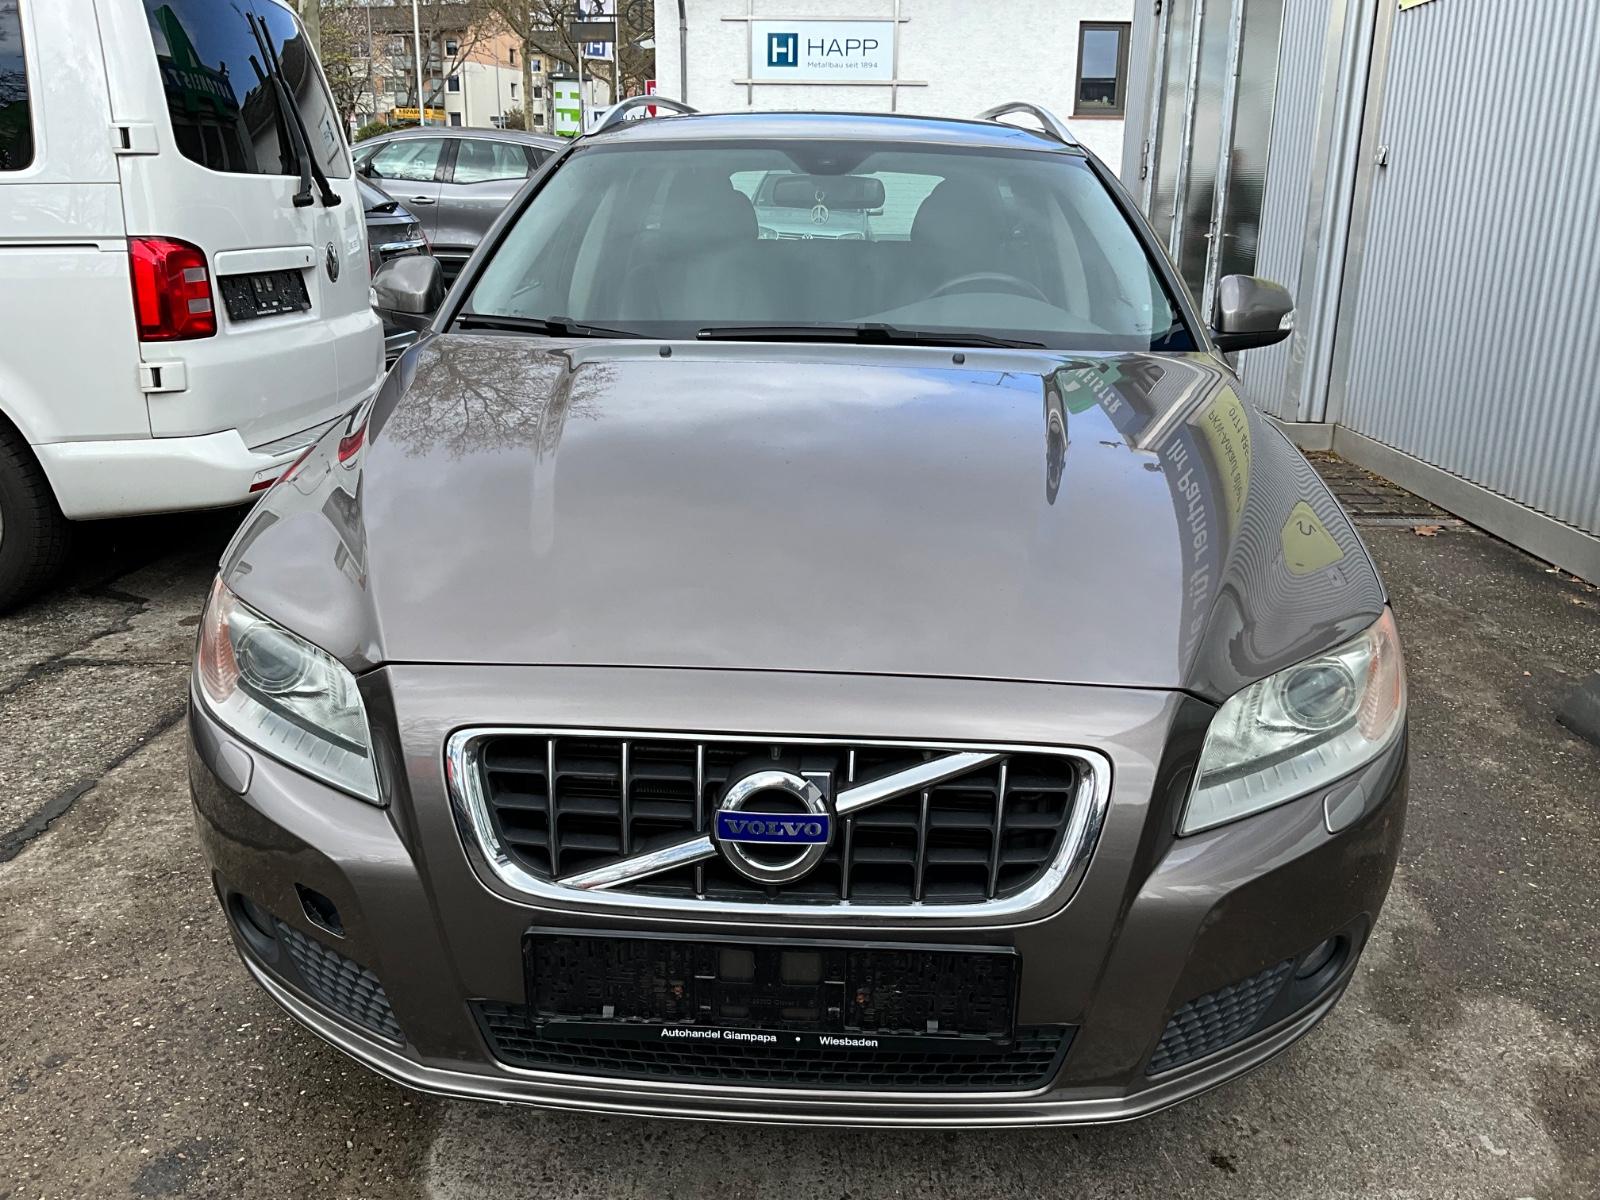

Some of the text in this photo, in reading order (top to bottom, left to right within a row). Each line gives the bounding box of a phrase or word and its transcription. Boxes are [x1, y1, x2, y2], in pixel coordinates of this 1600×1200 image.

[807, 38, 879, 57] HAPP
[807, 61, 878, 69] Metallbau seit 1894
[724, 818, 822, 837] VOLVO
[660, 1028, 879, 1047] Autohandel Giampapa Wiesbaden
